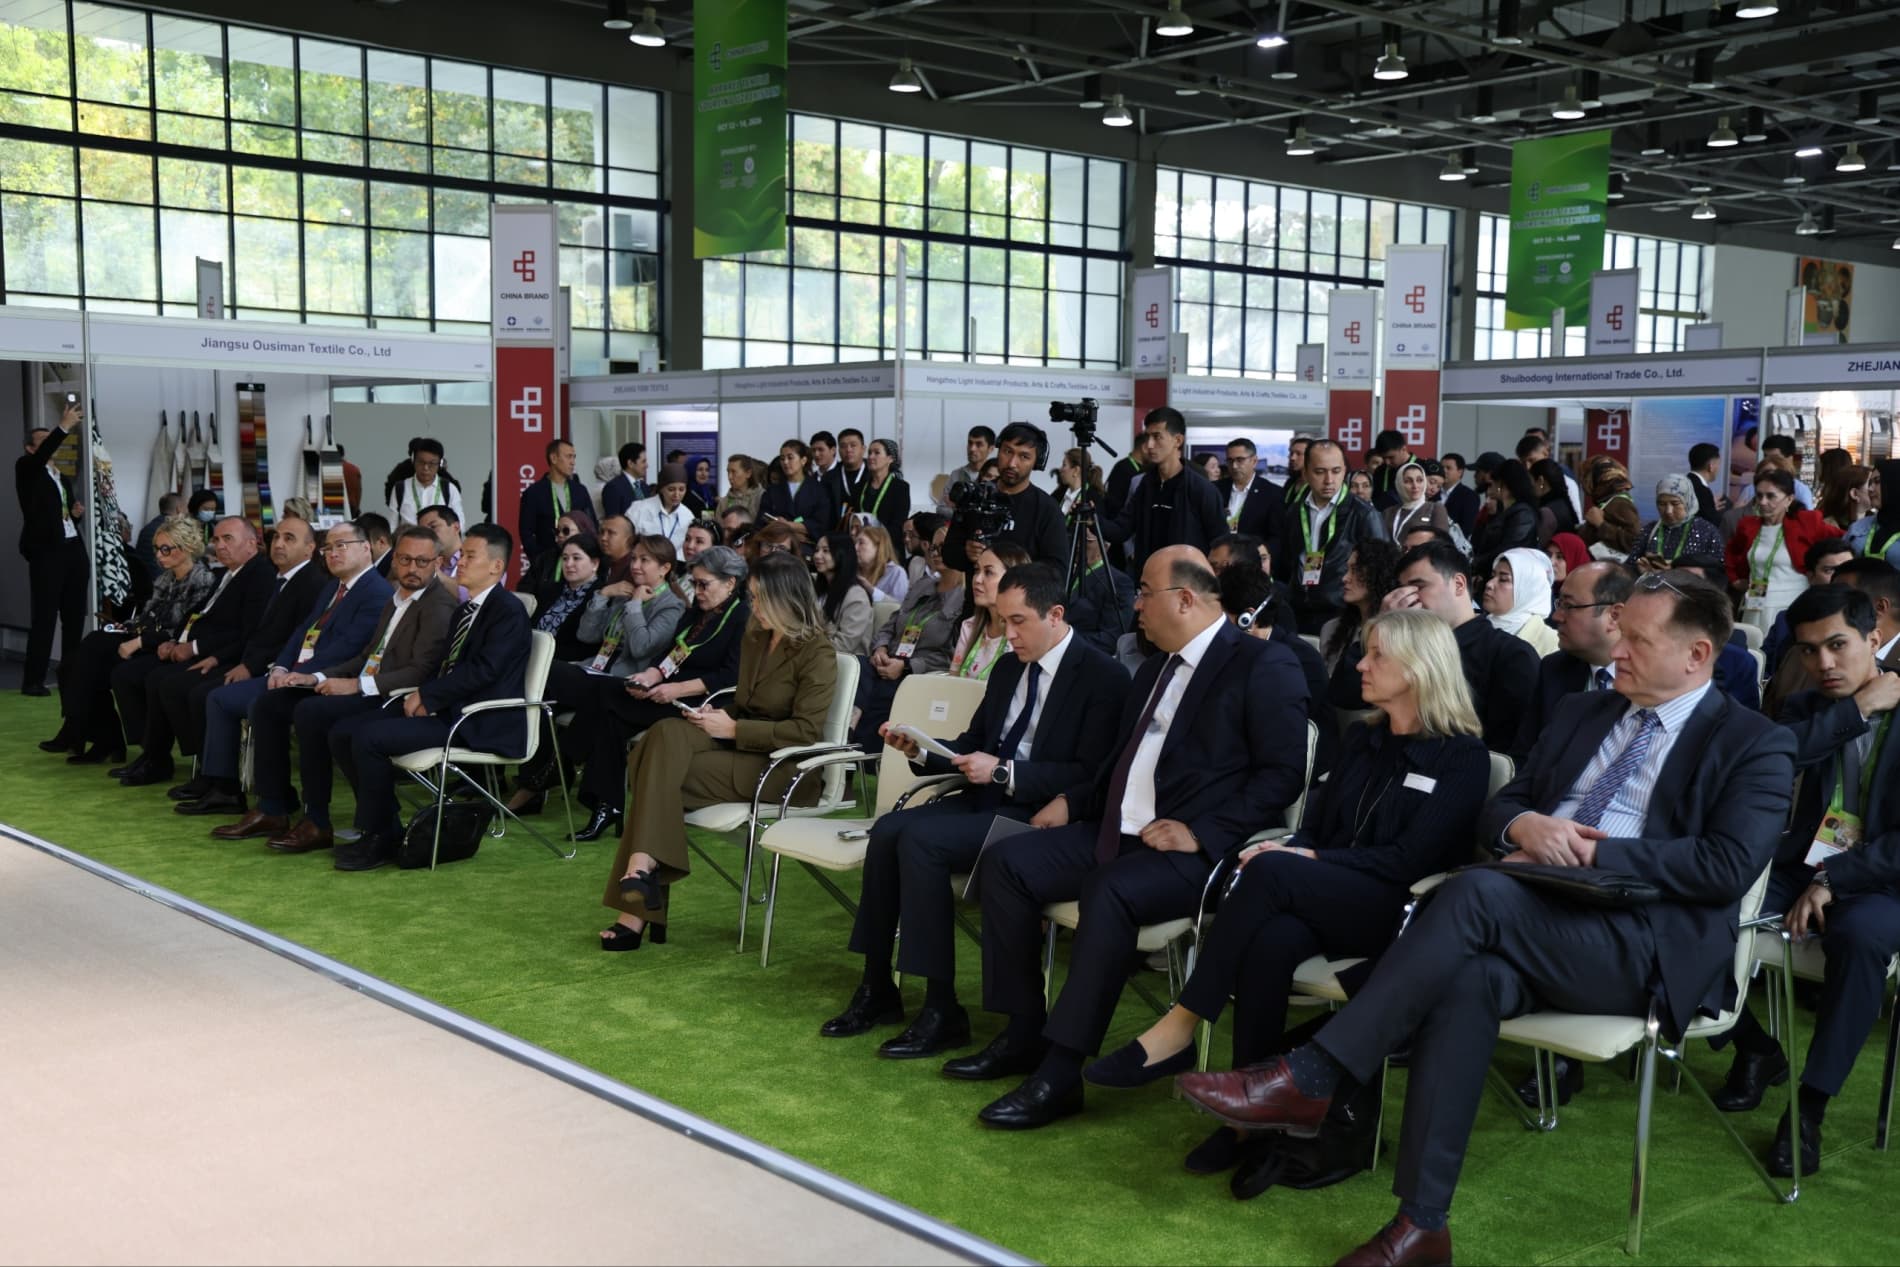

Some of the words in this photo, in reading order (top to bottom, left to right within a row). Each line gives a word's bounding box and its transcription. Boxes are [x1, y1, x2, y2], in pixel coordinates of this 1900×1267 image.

[500, 292, 522, 300] CHINA
[524, 292, 550, 300] BRAND
[201, 337, 249, 351] Jiangsu
[253, 339, 305, 353] Ousiman
[308, 343, 345, 355] Textile
[348, 345, 370, 357] Co.,
[373, 346, 391, 357] Ltd
[1847, 360, 1900, 372] ZHEJIAN
[1500, 373, 1553, 385] Shuibodong
[1555, 371, 1612, 382] International
[1615, 369, 1641, 380] Trade
[1644, 369, 1664, 380] Co.,
[1666, 368, 1685, 378] Ltd.
